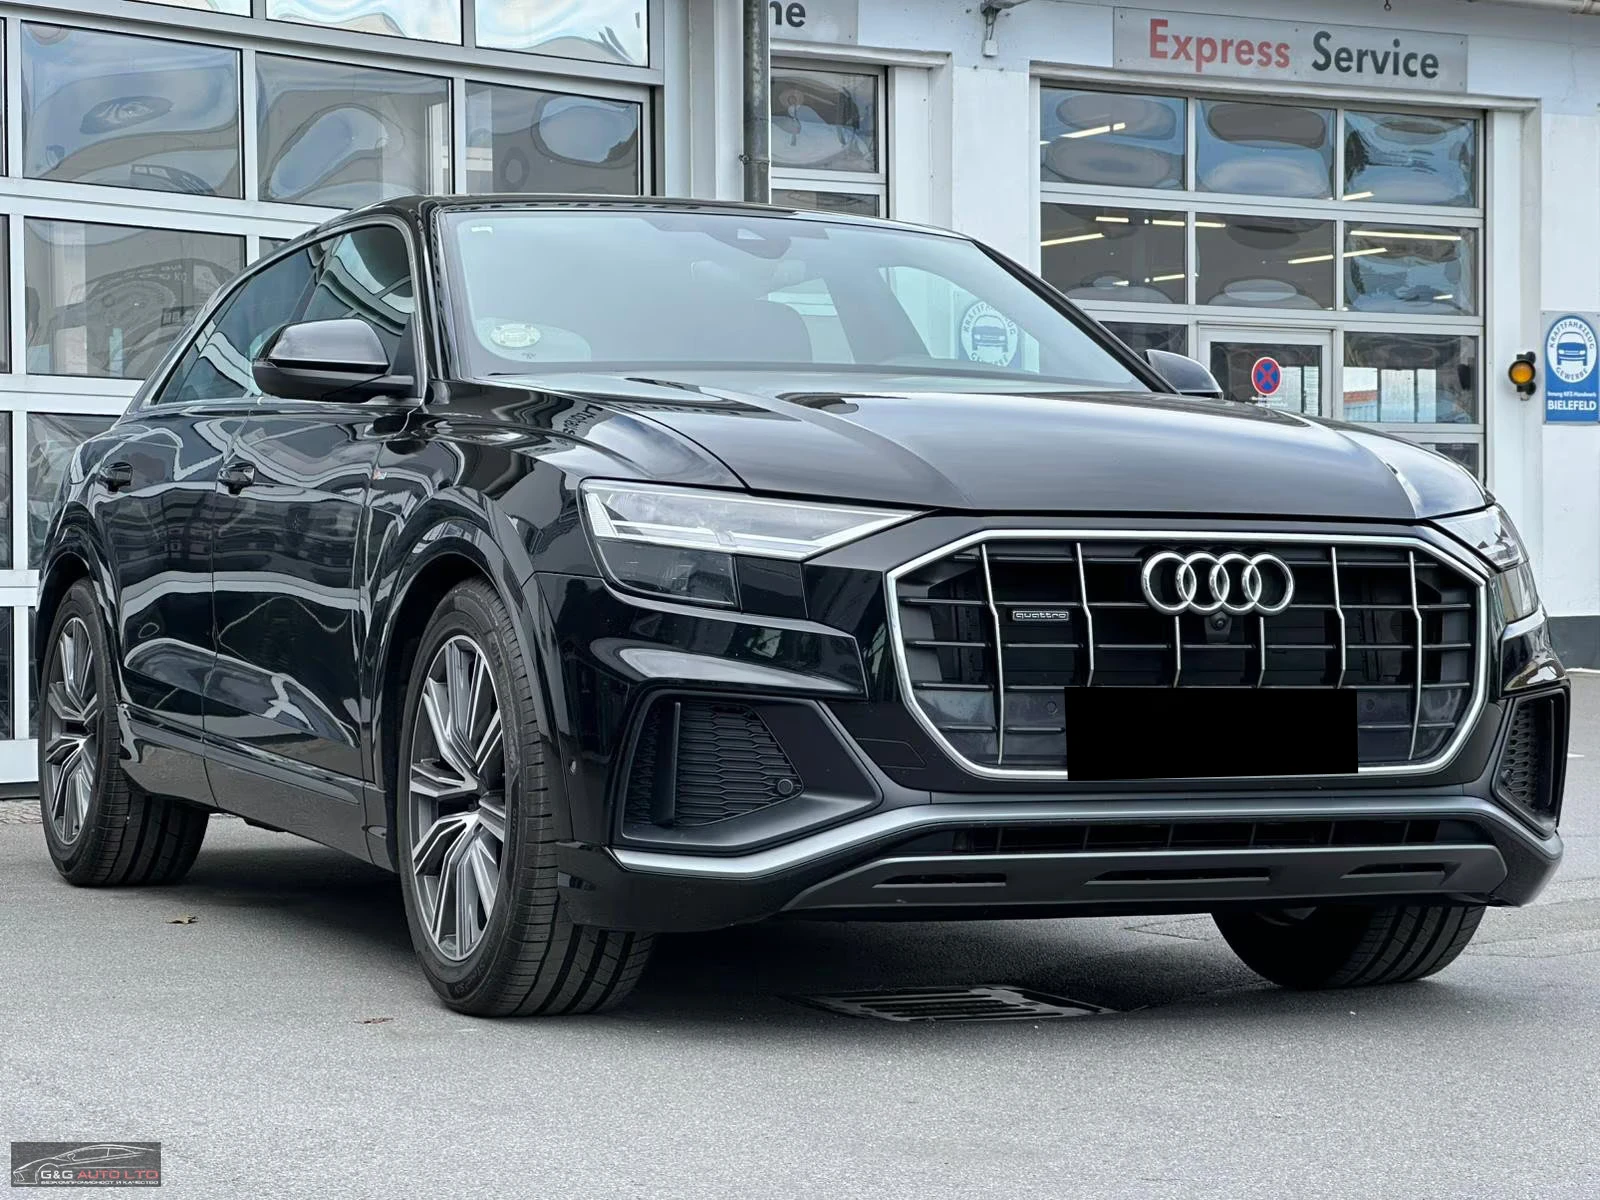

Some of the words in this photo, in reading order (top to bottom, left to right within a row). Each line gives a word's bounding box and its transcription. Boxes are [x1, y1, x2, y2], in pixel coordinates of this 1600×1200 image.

[1149, 18, 1291, 73] Express
[1311, 30, 1440, 79] Service
[1549, 320, 1595, 350] KRAFTFAHRZEUG
[1555, 366, 1589, 381] GEWERBE
[1547, 399, 1597, 411] BIELEFELD
